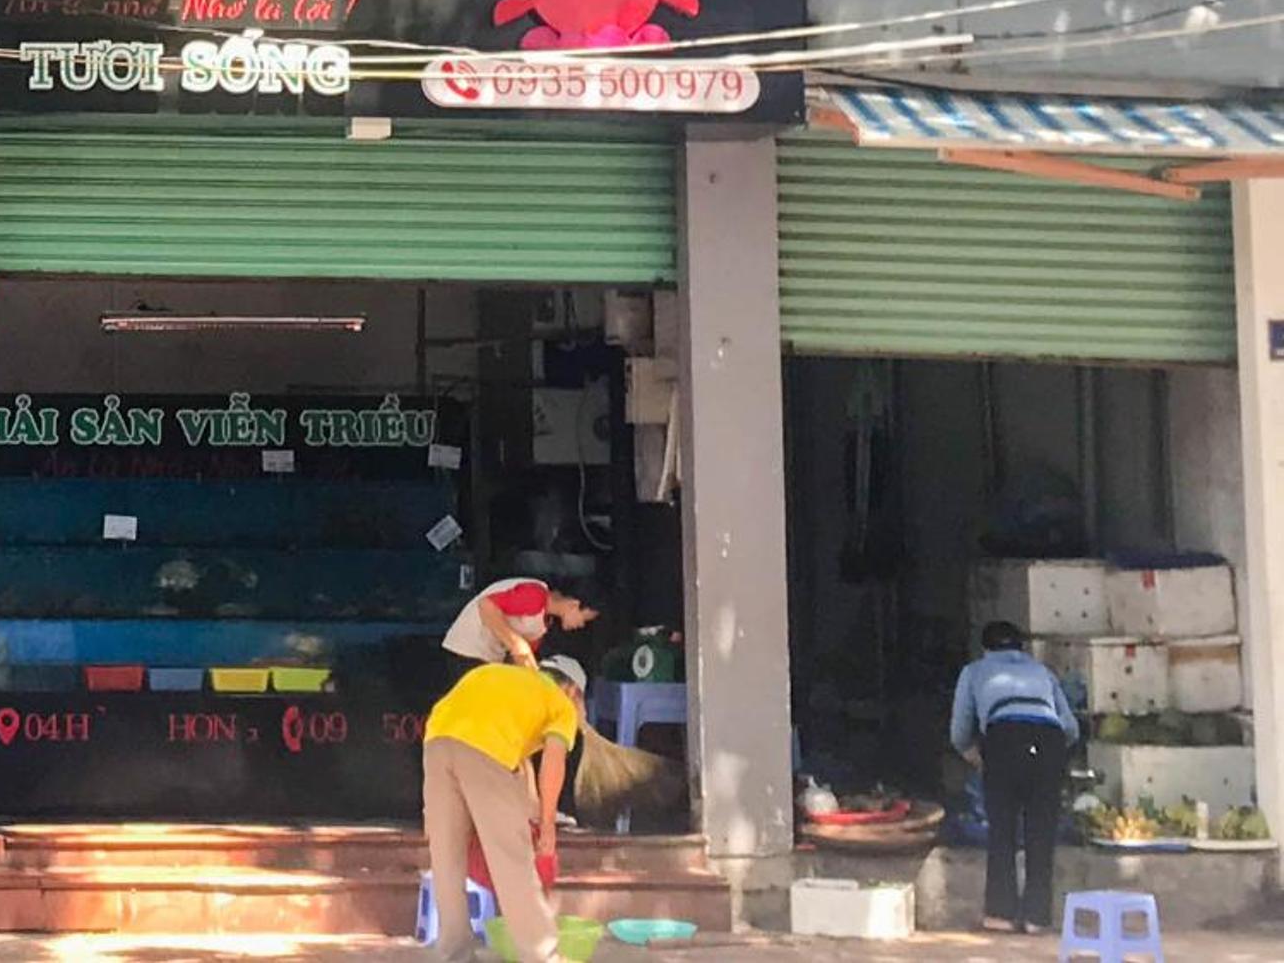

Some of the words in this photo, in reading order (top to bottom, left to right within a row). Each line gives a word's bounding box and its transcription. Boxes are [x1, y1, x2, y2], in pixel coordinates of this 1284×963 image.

[20, 40, 165, 91] TƯƠI
[181, 28, 350, 95] SỐNG
[493, 64, 586, 98] 0935
[598, 67, 667, 99] 500
[676, 69, 743, 101] 979
[70, 394, 164, 446] SẢN
[176, 392, 286, 446] VIỄN
